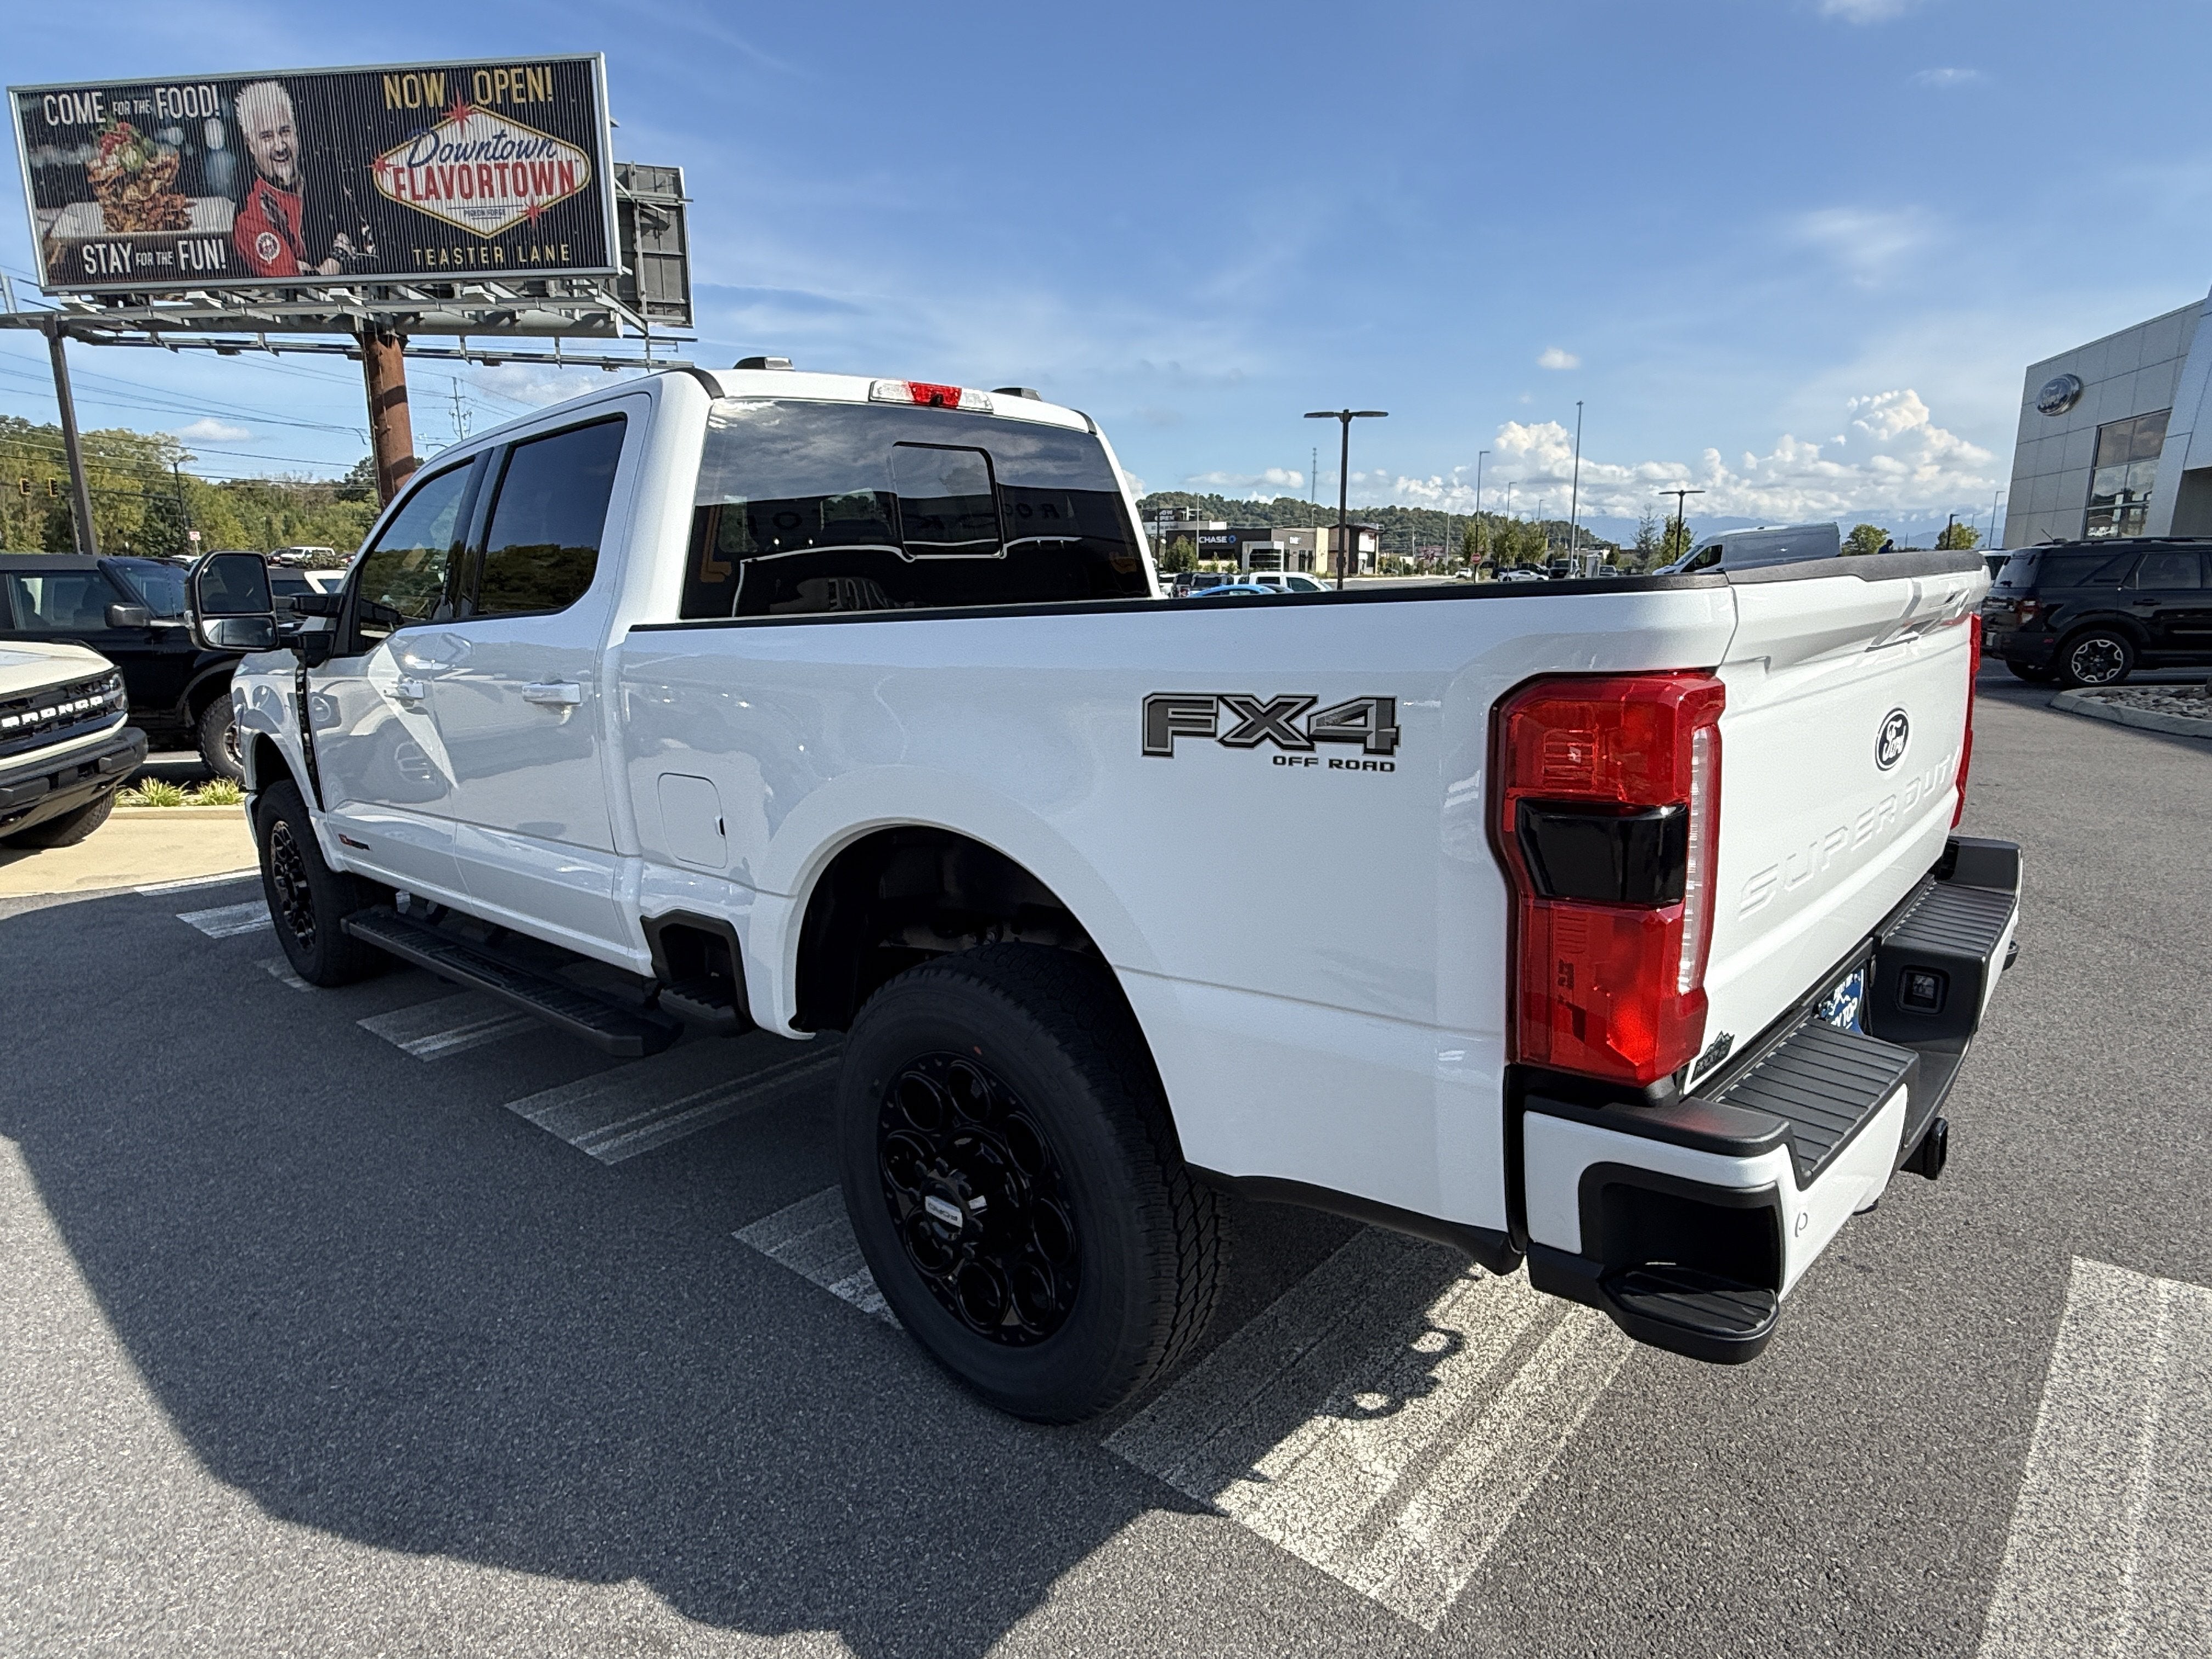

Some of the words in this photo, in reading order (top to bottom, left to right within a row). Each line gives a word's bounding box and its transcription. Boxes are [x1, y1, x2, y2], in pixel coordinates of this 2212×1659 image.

[43, 91, 106, 126] COME
[112, 100, 131, 116] FOR
[133, 99, 151, 115] THE
[155, 84, 220, 120] FOOD!
[383, 72, 445, 110] NOW
[473, 66, 553, 105] OPEN!
[408, 128, 557, 168] Downtown
[393, 160, 575, 201] FLAVORTOWN
[82, 242, 132, 274] STAY
[136, 252, 154, 267] FOR
[155, 251, 174, 266] THE
[177, 238, 227, 271] FUN!
[413, 246, 504, 266] TEASTER
[517, 244, 570, 263] LANE
[1, 695, 104, 728] BRONCO
[1142, 691, 1401, 758] FX4
[1273, 755, 1319, 767] OFF
[1328, 758, 1396, 772] ROAD
[1738, 793, 1898, 922] SUPER
